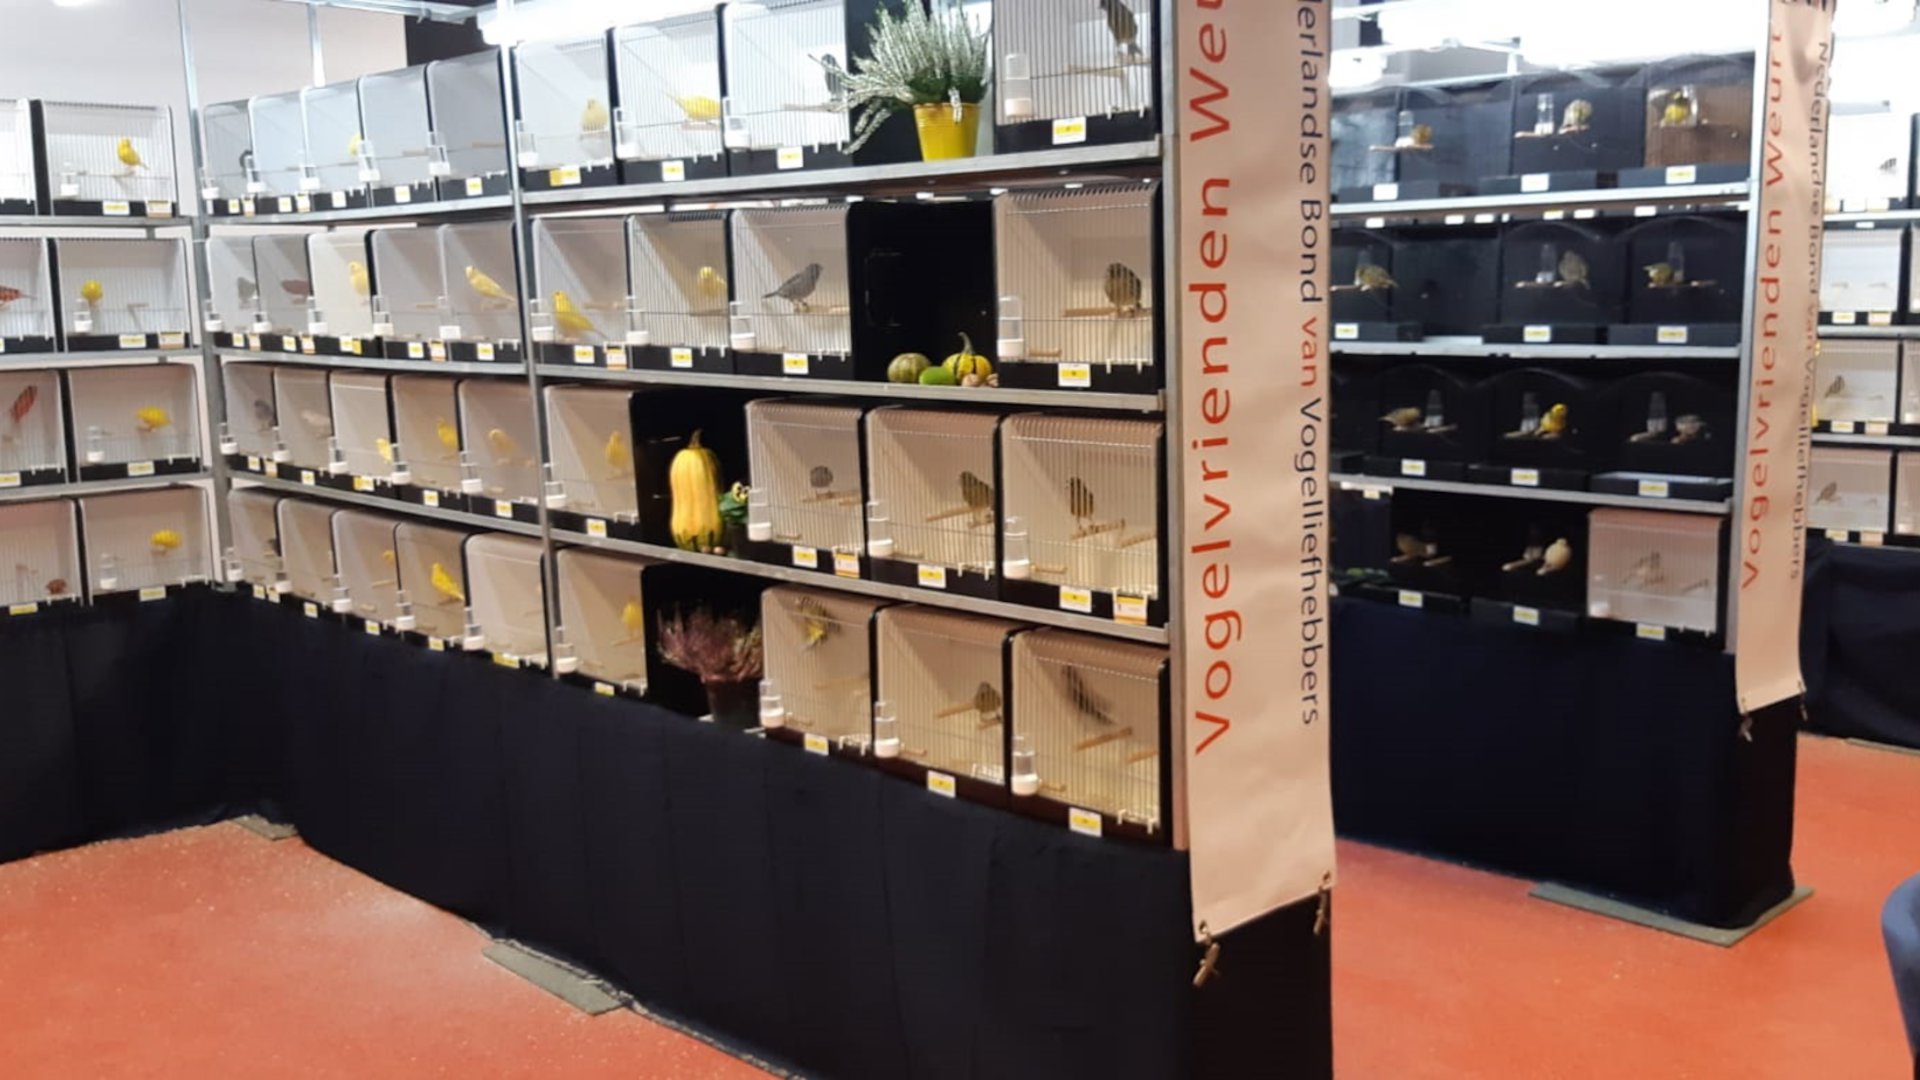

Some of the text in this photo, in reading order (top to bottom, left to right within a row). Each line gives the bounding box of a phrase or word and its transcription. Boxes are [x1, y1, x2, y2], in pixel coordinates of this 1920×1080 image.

[1188, 177, 1243, 756] Vogelvrienden
[1294, 0, 1325, 726] erlandse Bond van Vogelliefhebbers
[1742, 209, 1783, 590] Vogelvrienden
